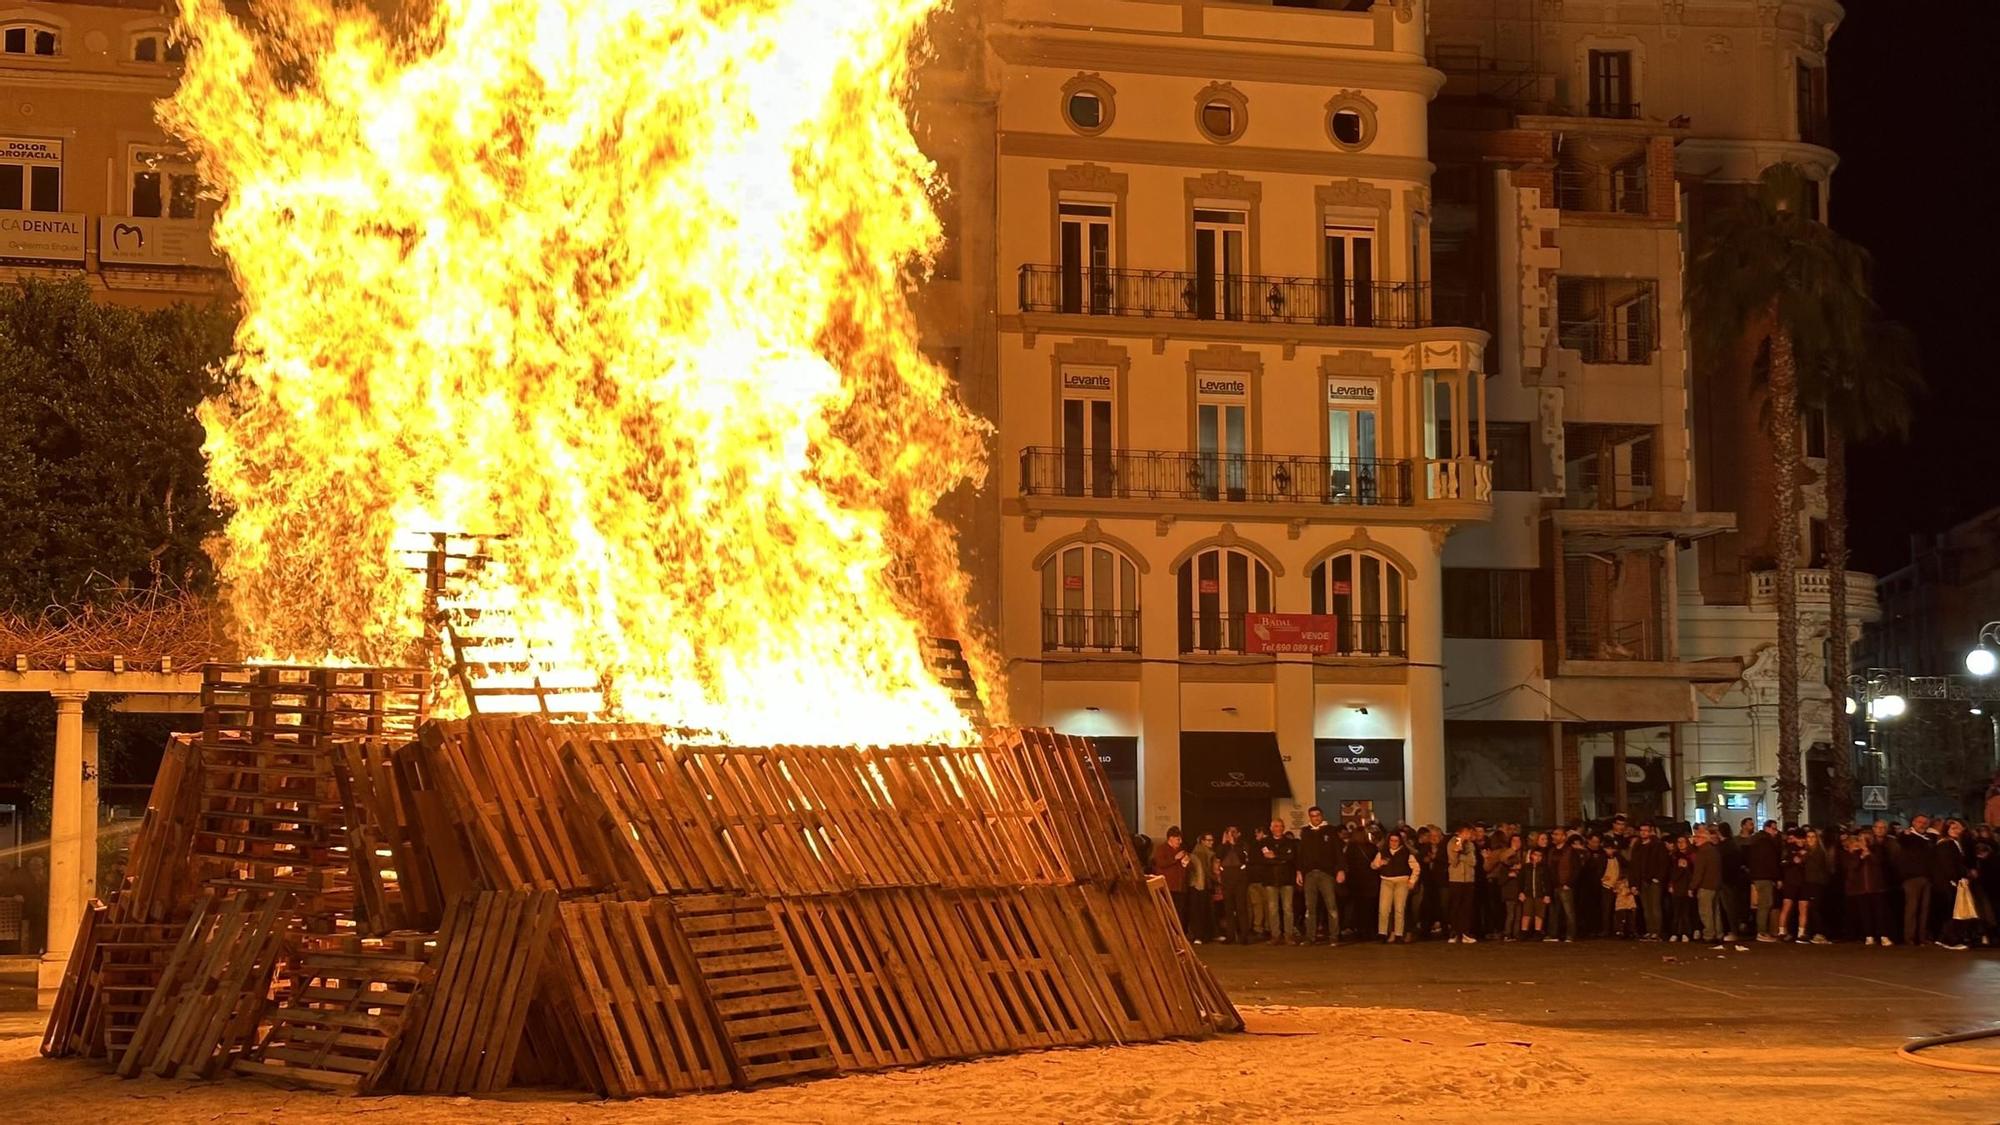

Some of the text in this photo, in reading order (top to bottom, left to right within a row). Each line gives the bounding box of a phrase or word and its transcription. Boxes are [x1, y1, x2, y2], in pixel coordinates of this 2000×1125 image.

[9, 143, 47, 151] DOLOR
[1064, 372, 1110, 385] Levante
[1199, 379, 1244, 391] Levante
[1330, 384, 1374, 396] Levante
[1301, 632, 1329, 640] VENDE
